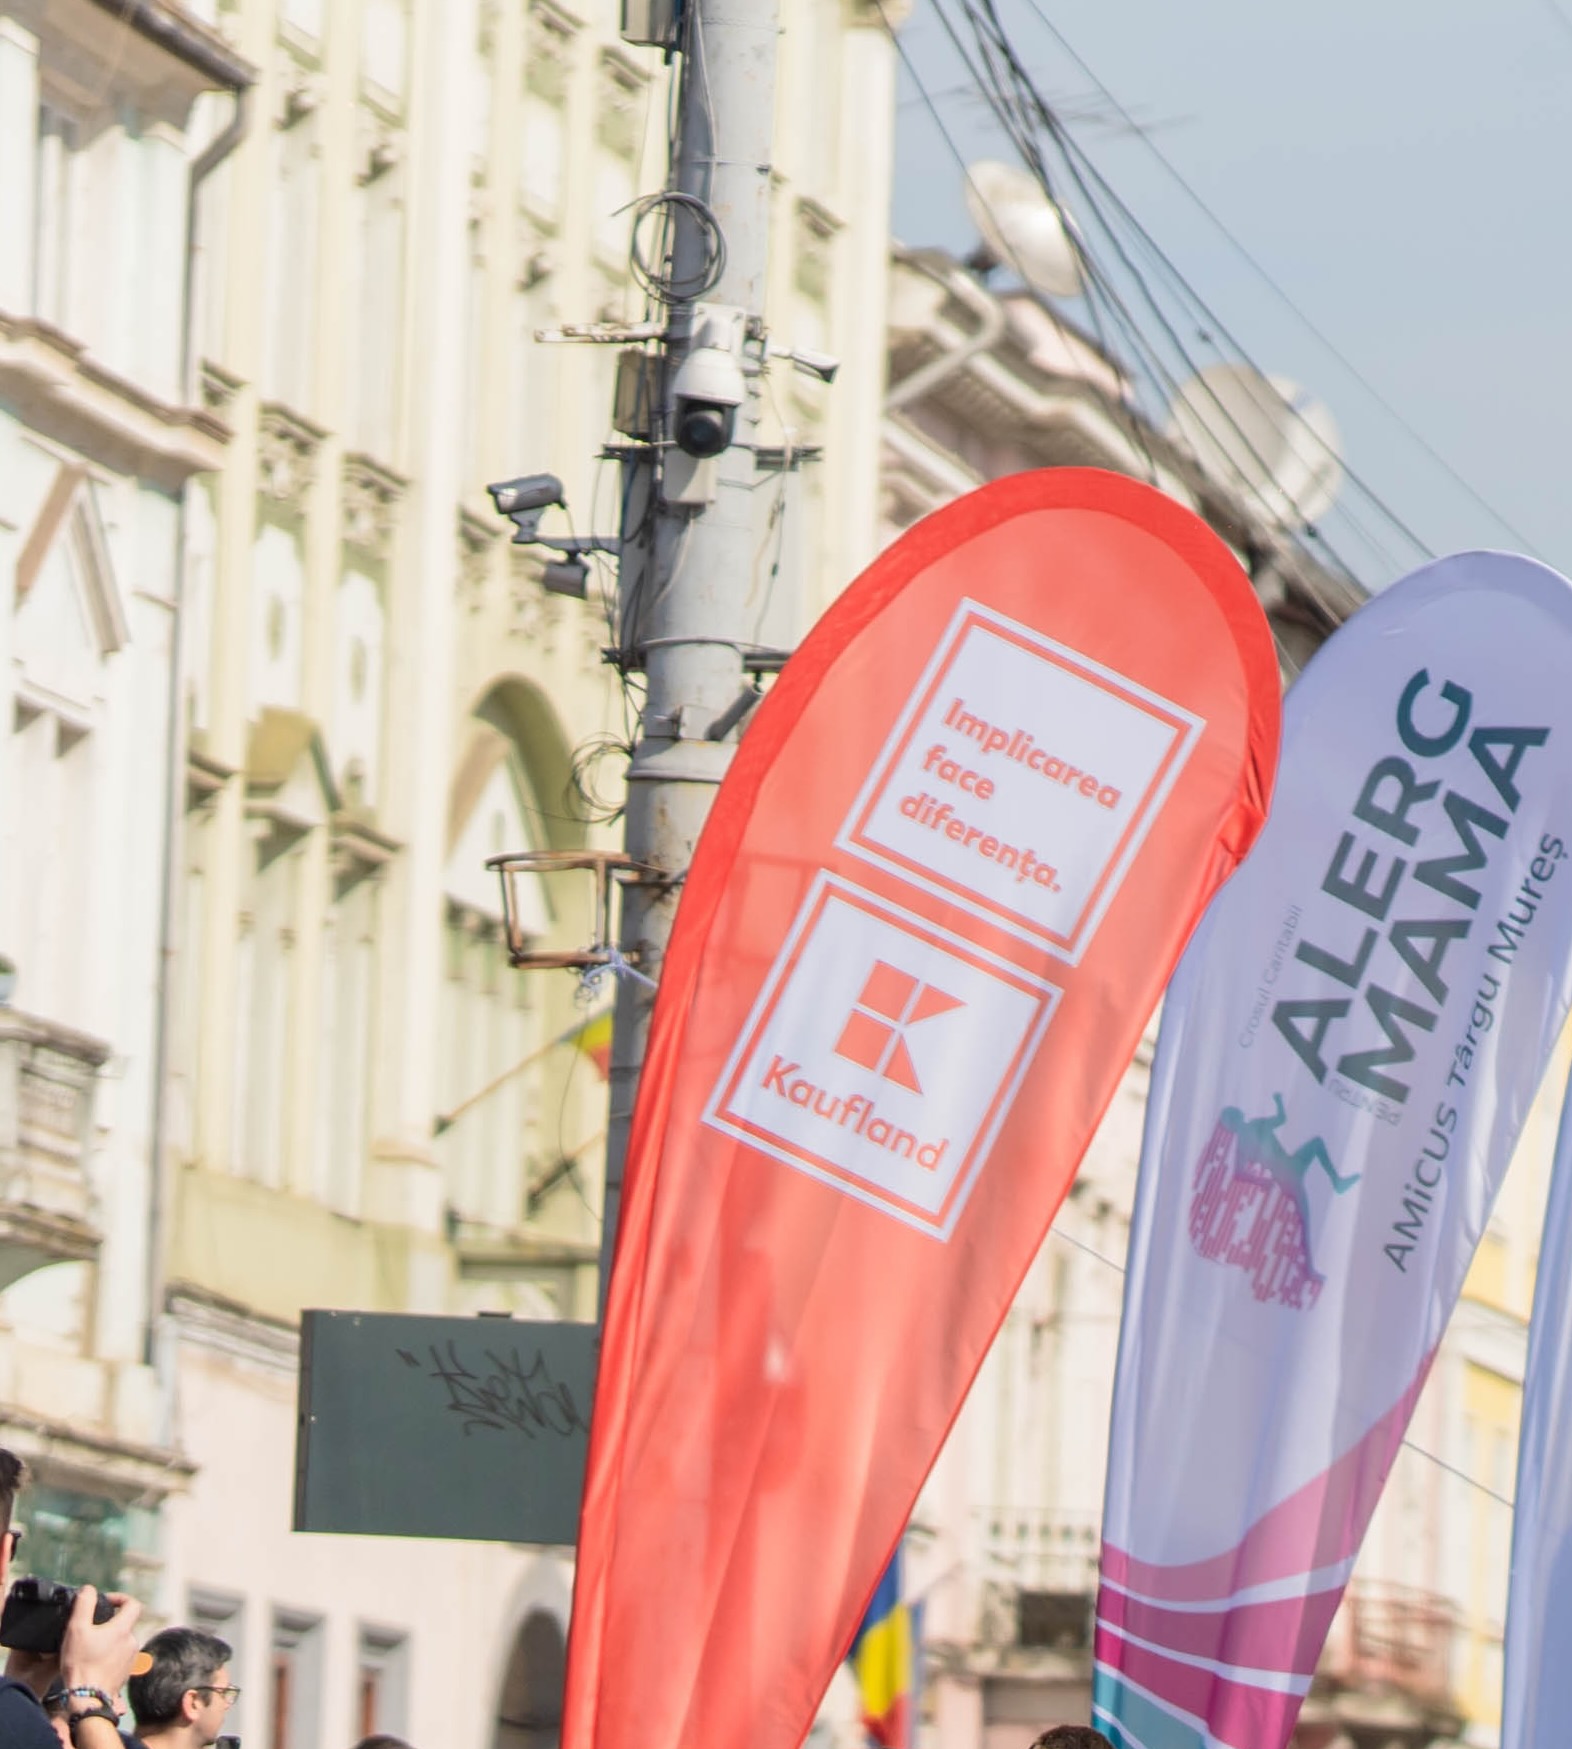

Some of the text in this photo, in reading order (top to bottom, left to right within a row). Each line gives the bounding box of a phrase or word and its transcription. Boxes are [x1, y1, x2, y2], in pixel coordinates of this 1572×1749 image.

[923, 744, 996, 802] face
[944, 698, 1124, 811] Implicarea
[901, 791, 1061, 894] diferența.
[1272, 667, 1473, 1085] ALERG
[1238, 903, 1303, 1048] Crosul Caritabil
[1336, 726, 1550, 1104] MAMA
[1447, 971, 1502, 1089] Târgu
[1488, 833, 1569, 965] Mureș
[761, 1054, 949, 1173] Kaufland
